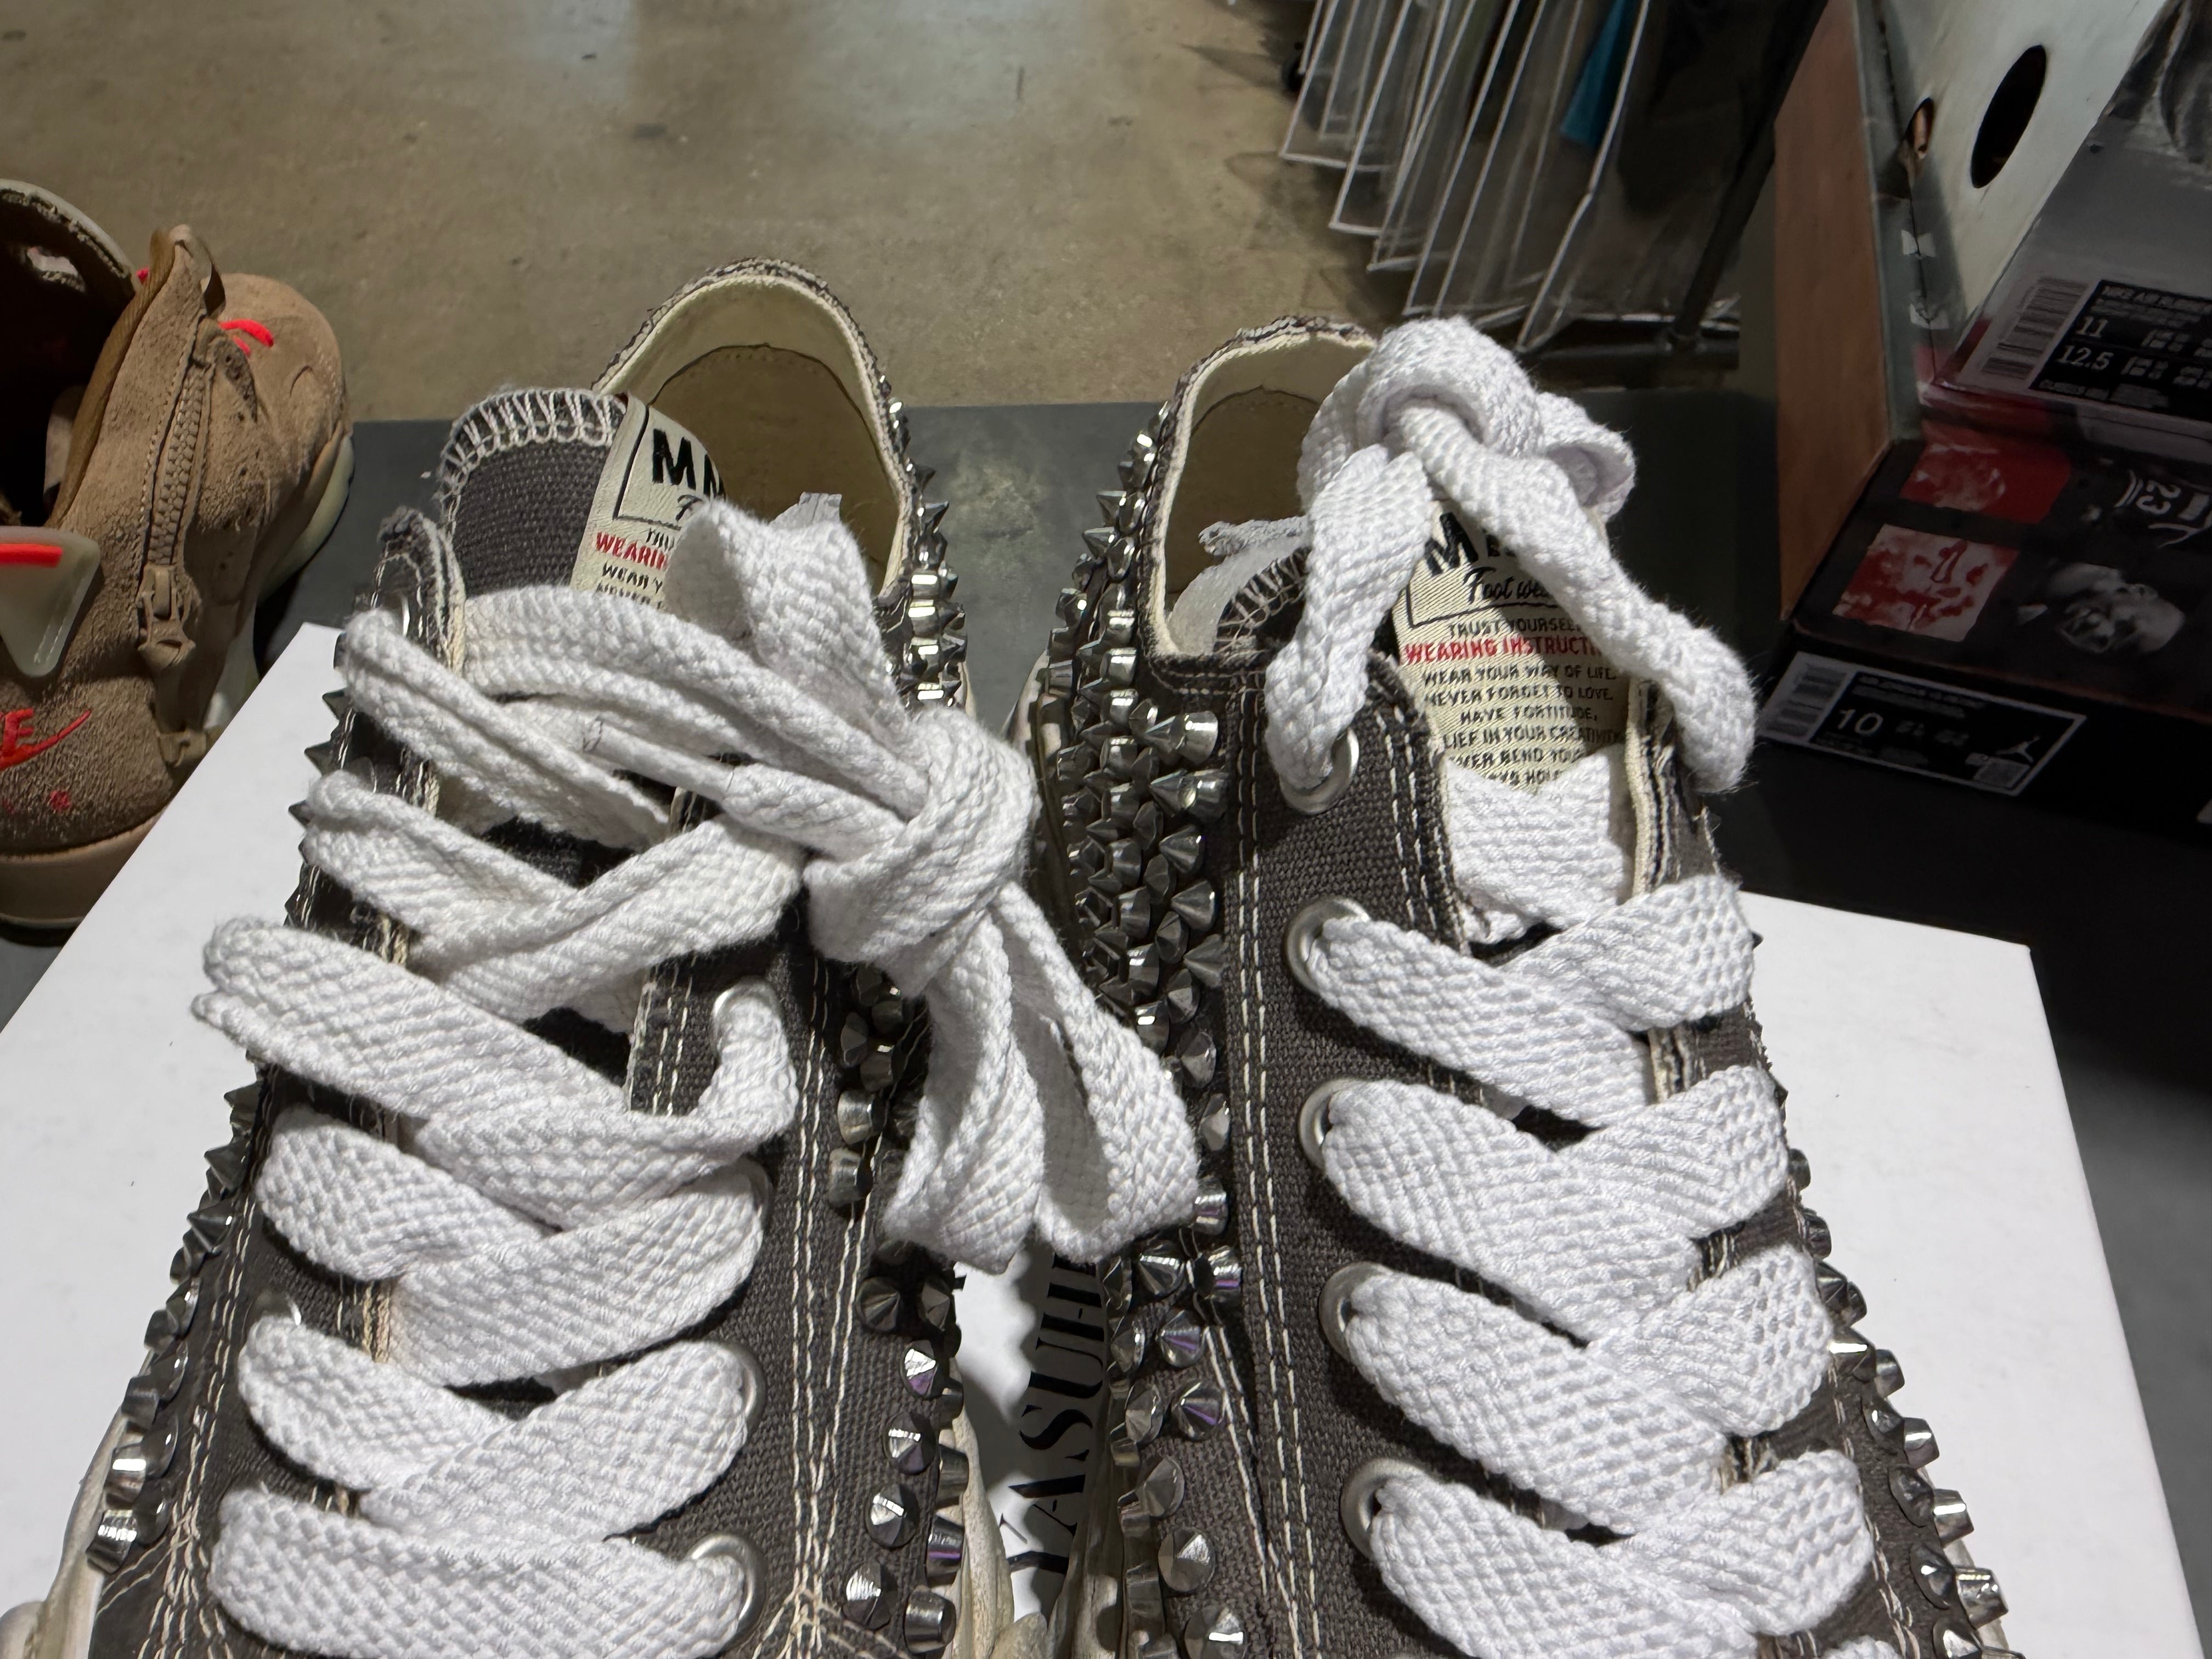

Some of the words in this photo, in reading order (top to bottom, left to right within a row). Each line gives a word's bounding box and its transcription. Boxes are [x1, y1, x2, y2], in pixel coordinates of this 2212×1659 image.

[2074, 315, 2109, 339] 11
[2055, 343, 2115, 373] 12.5
[2135, 479, 2182, 515] 23
[1449, 617, 1502, 639] TRUST
[1404, 637, 1498, 665] WEARING
[1503, 635, 1602, 657] INSTRUCTI
[1422, 667, 1472, 687] WEAR
[1475, 664, 1519, 681] YOUR
[1525, 664, 1559, 680] WAY
[1565, 664, 1582, 680] OF
[1587, 665, 1617, 681] LIFE
[1424, 689, 1482, 708] NEVER
[1485, 684, 1554, 702] FORGET
[1556, 684, 1573, 699] TO
[1578, 686, 1614, 701] LOVE
[1460, 707, 1506, 725] HAVE
[1835, 708, 1885, 737] 10
[1483, 726, 1502, 745] IN
[1503, 726, 1544, 743] YOUR
[1499, 747, 1544, 765] BEND
